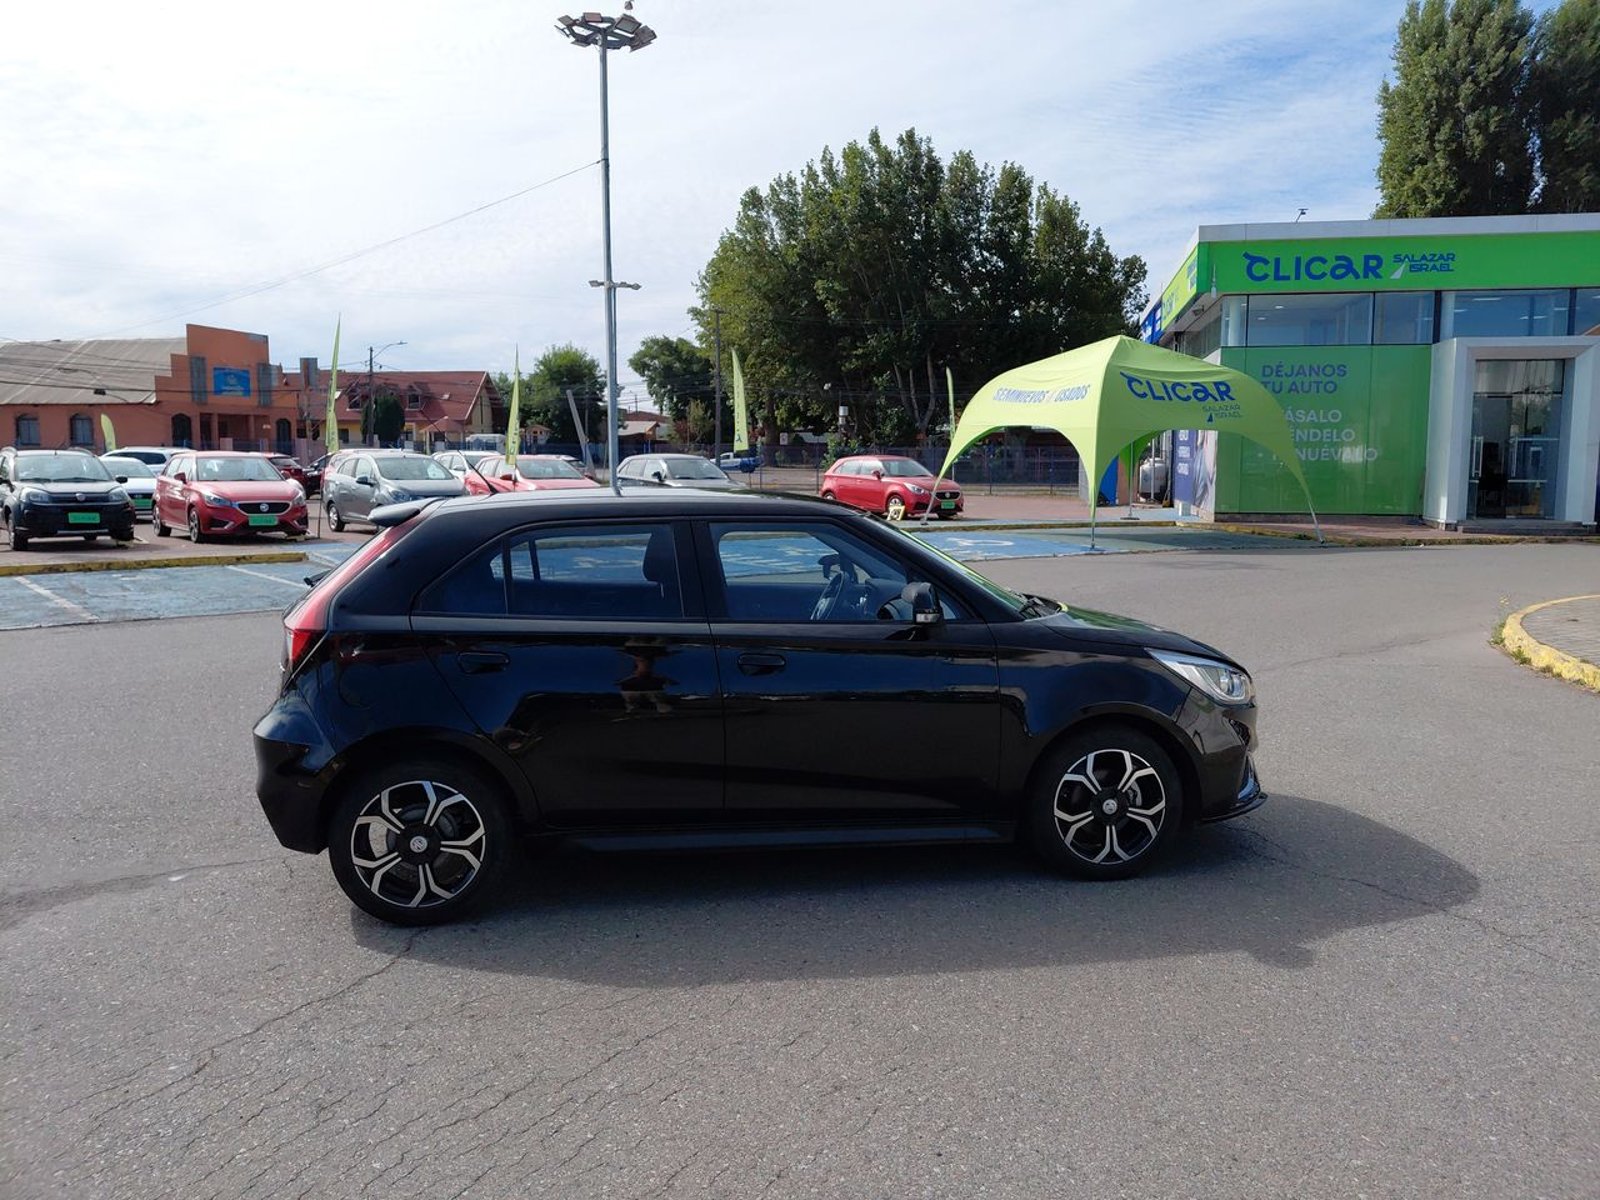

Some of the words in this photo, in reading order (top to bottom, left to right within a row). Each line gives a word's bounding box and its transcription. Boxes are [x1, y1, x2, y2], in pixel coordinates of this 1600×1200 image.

[1392, 252, 1456, 264] SALAZAR
[1409, 263, 1455, 273] ISRAEL
[1261, 361, 1348, 378] DÉJANOS
[1287, 381, 1338, 394] AUTO
[1284, 406, 1342, 423] ÁSALO
[1290, 424, 1356, 441] ÉNDELO
